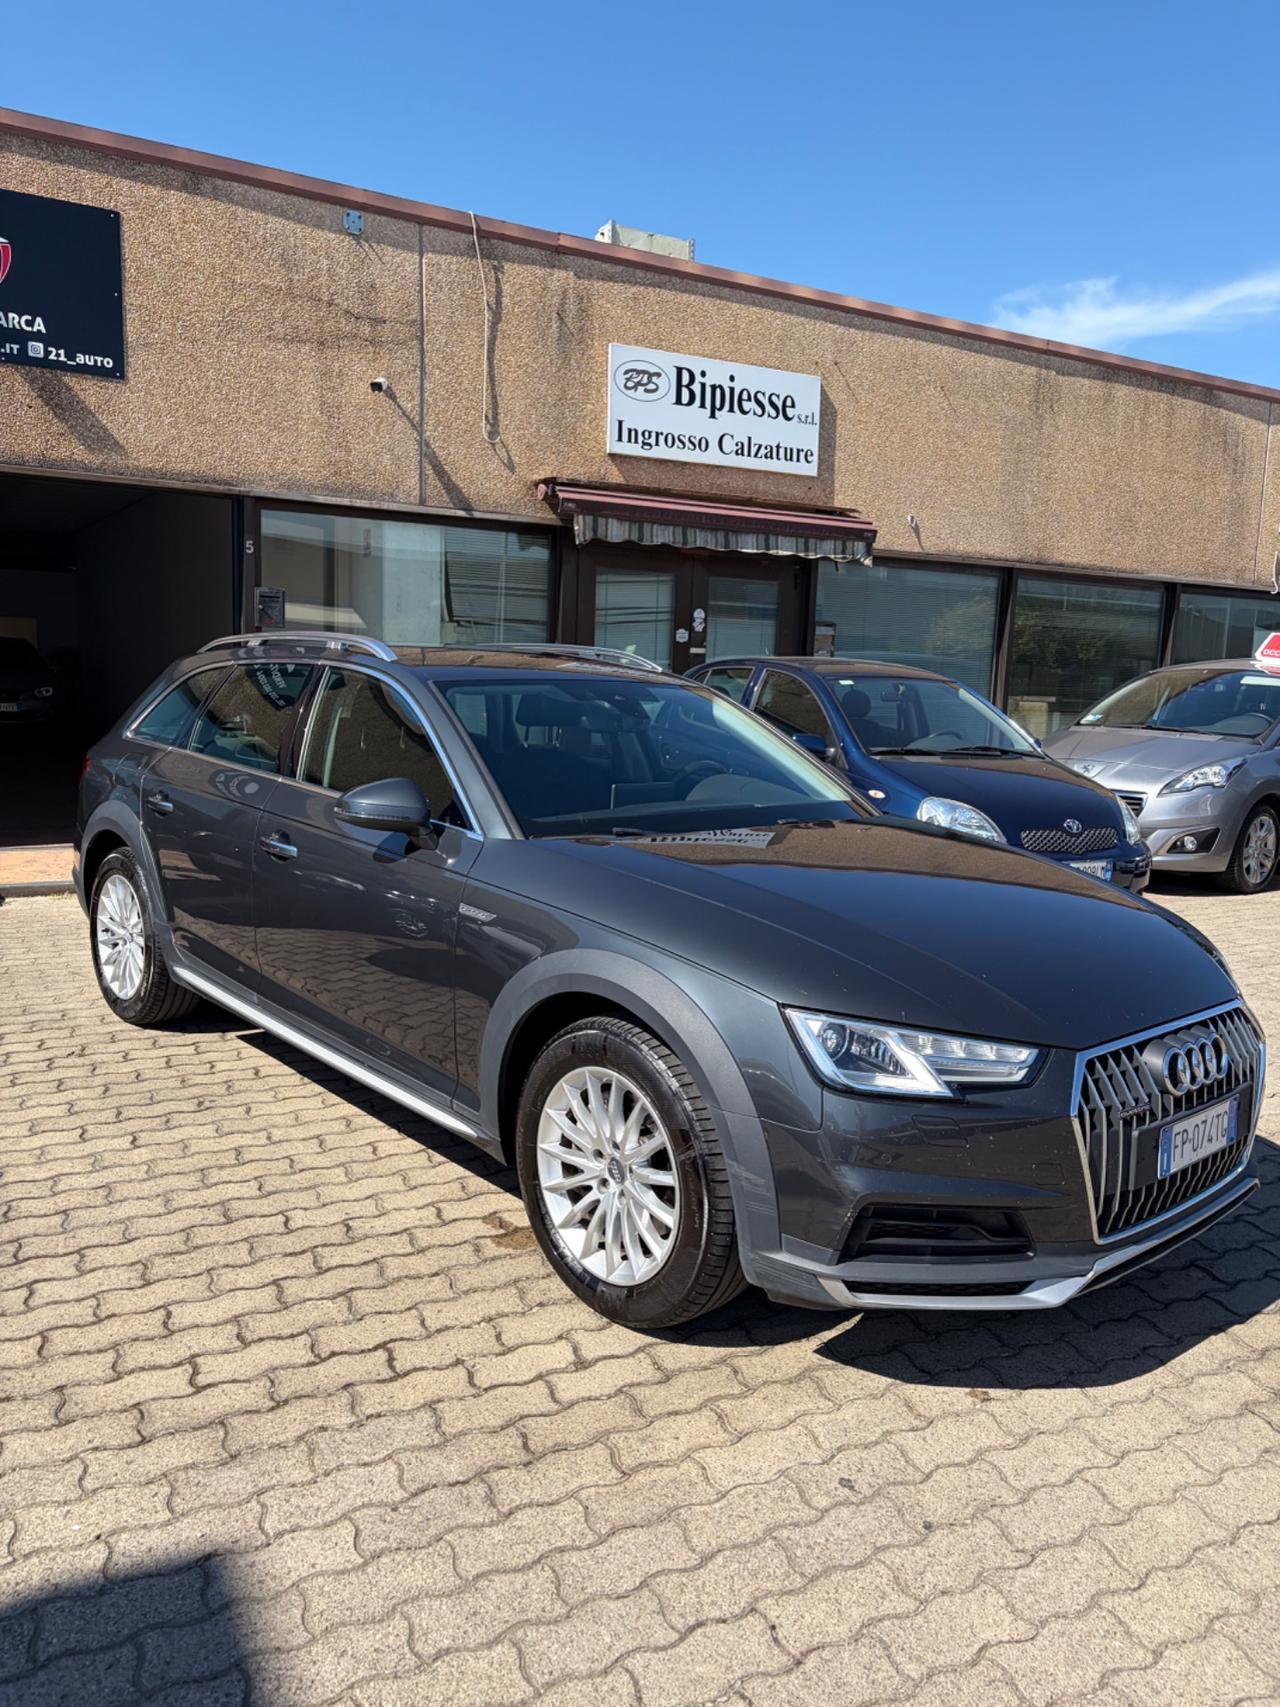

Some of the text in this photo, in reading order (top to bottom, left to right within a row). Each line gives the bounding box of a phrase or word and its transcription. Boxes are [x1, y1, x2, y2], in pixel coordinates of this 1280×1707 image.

[672, 365, 818, 426] Bipiesse s.r.l.
[616, 418, 814, 465] Ingrosso Calzature
[245, 540, 255, 554] 5
